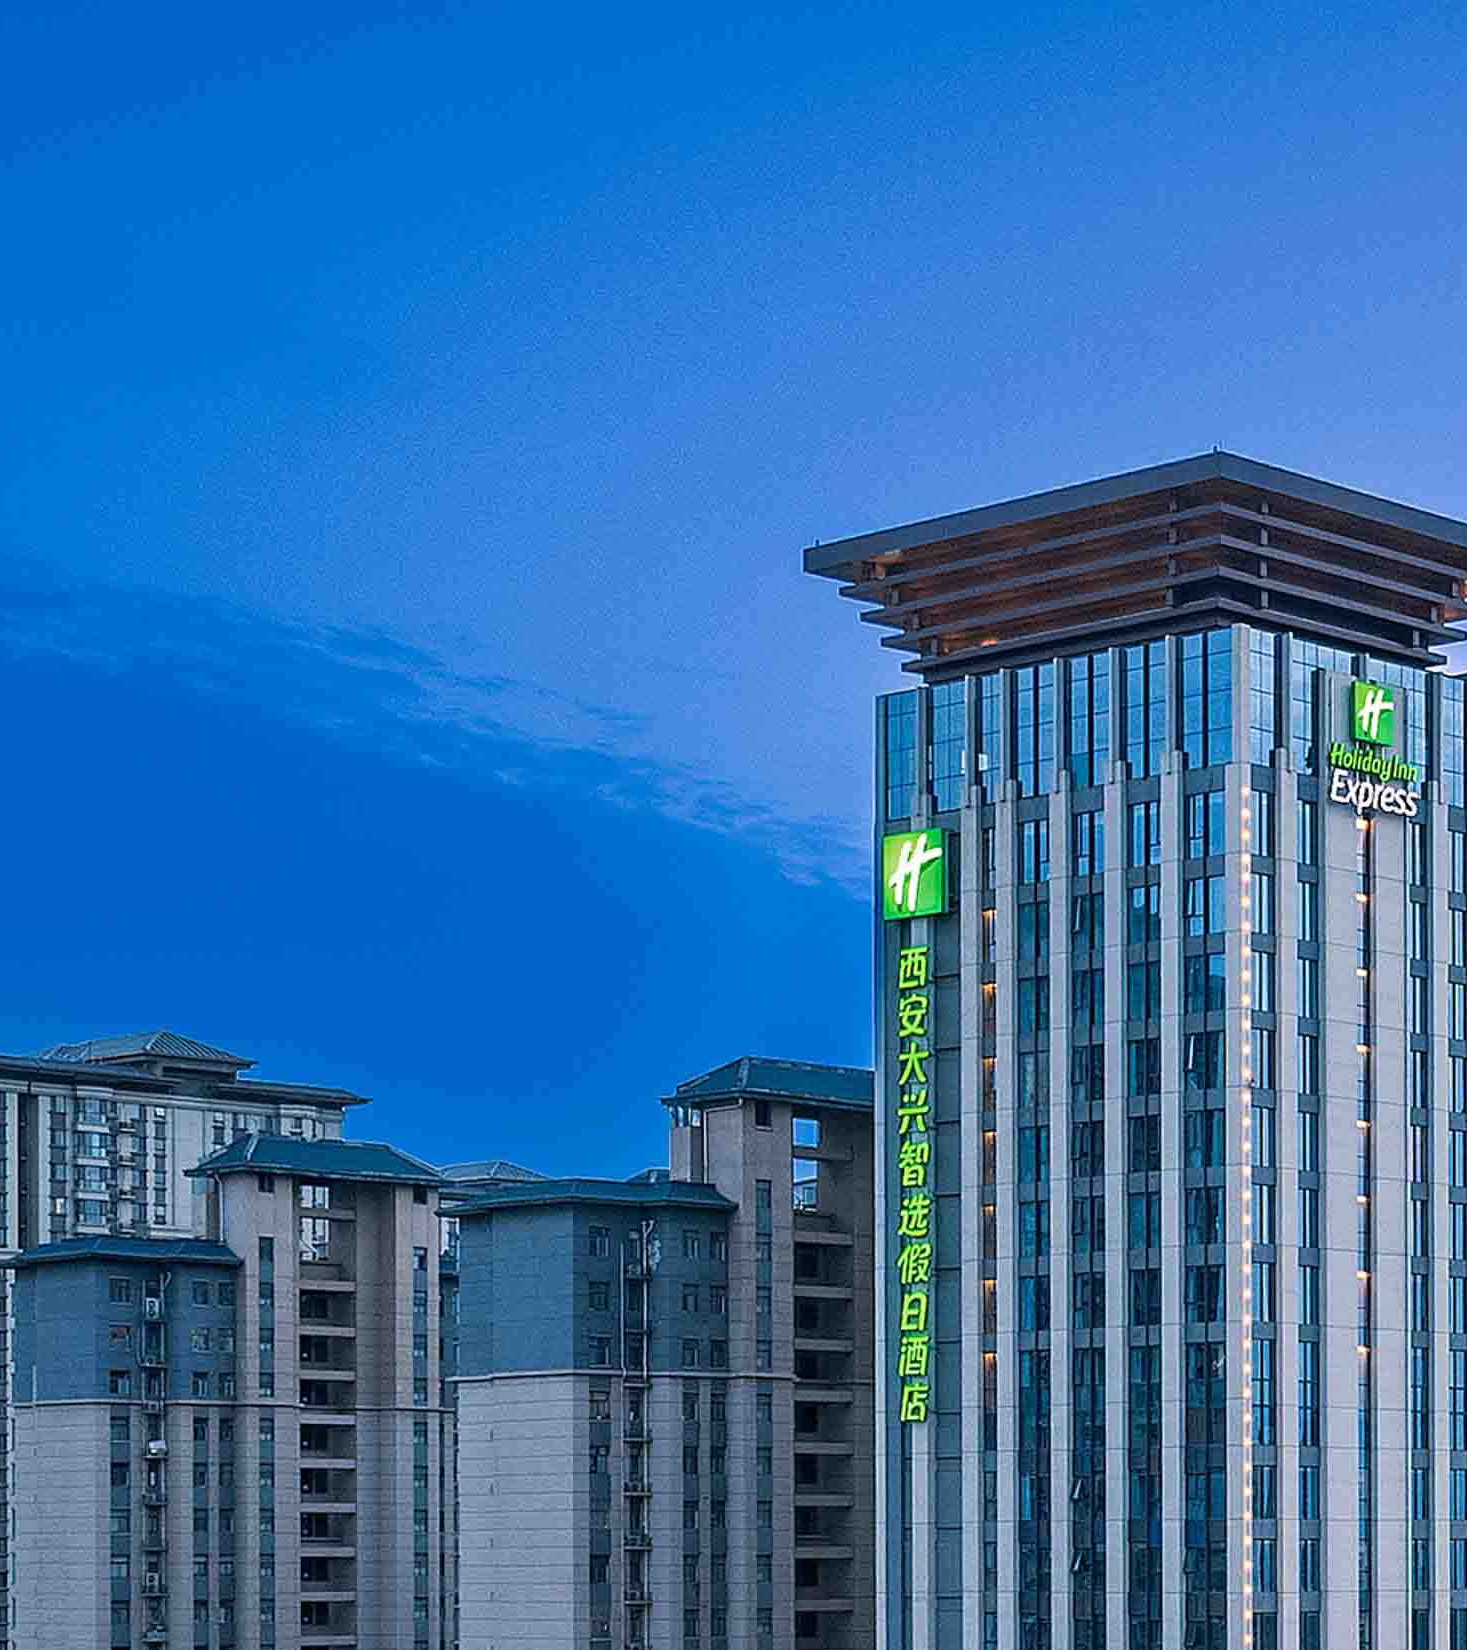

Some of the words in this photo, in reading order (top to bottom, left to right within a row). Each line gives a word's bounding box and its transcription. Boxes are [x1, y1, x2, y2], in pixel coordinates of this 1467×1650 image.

[1330, 741, 1391, 782] Holiday
[1393, 754, 1418, 782] Inn
[1330, 767, 1421, 817] Express
[896, 945, 930, 1424] 西安大兴智选假日酒店
